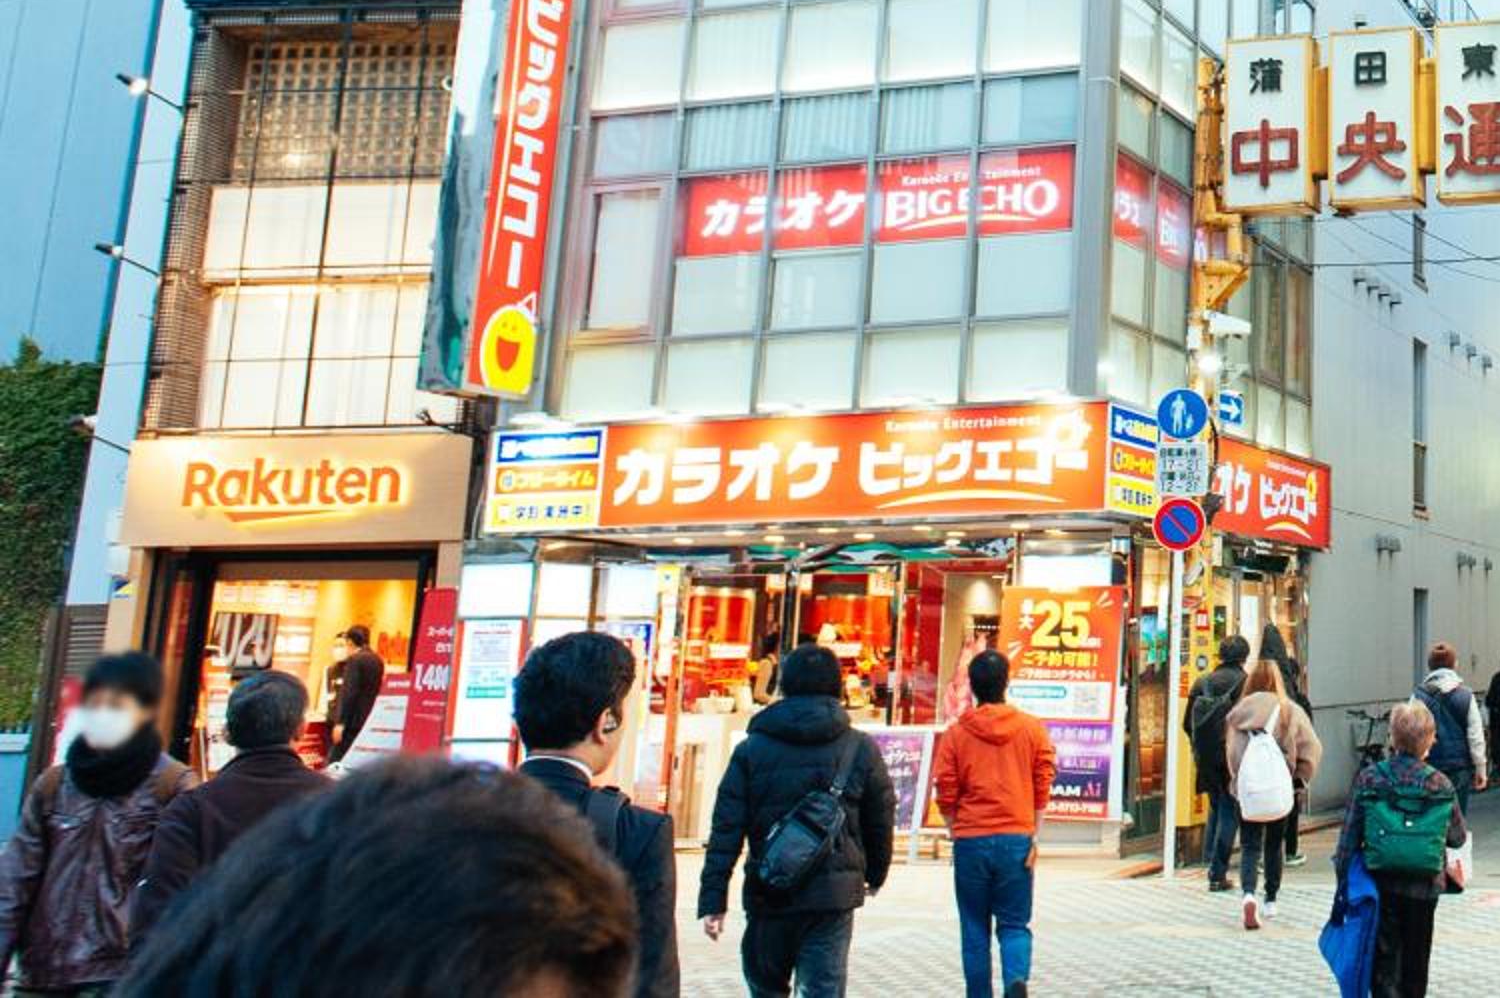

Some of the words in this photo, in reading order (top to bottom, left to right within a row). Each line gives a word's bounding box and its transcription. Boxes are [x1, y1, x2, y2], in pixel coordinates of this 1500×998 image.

[701, 189, 867, 238] カラオケ
[884, 188, 953, 229] BIG
[957, 179, 1060, 217] ECHO
[182, 458, 401, 508] Rakuten
[613, 440, 840, 507] カラオケ
[1031, 600, 1091, 649] 25
